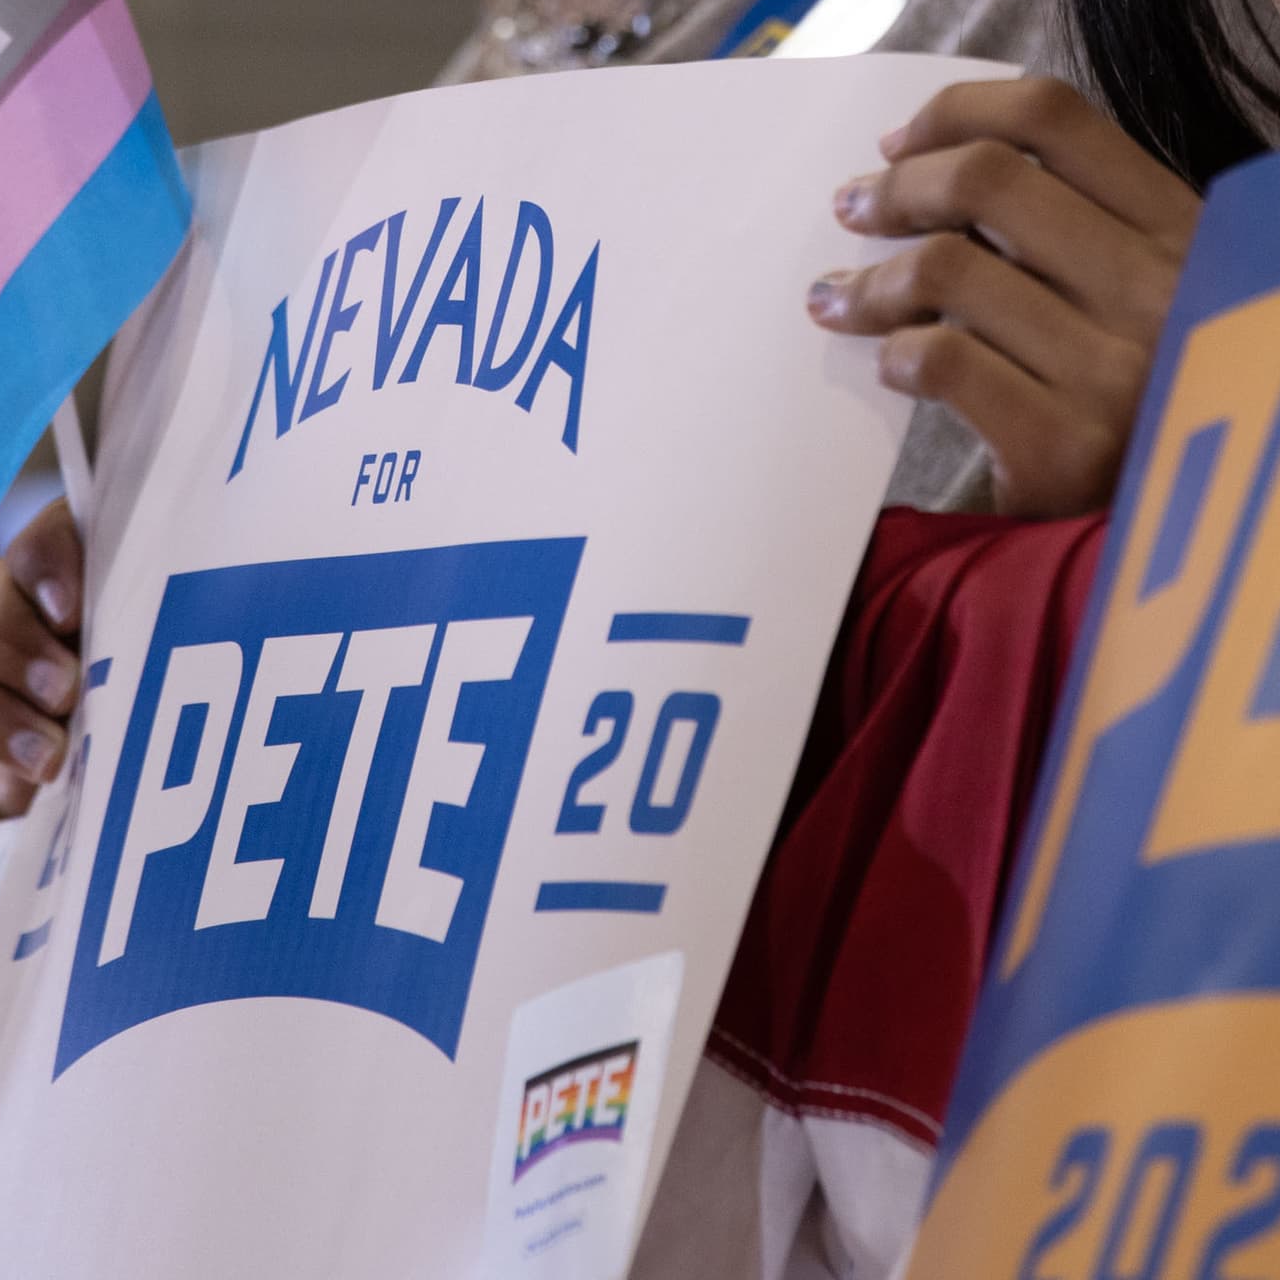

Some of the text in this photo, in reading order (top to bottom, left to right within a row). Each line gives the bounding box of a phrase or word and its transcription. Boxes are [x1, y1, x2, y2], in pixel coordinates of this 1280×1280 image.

[228, 194, 600, 484] NEVADA
[351, 449, 422, 506] FOR
[96, 615, 536, 967] PETE
[553, 689, 721, 837] 20
[521, 1055, 634, 1161] PETE
